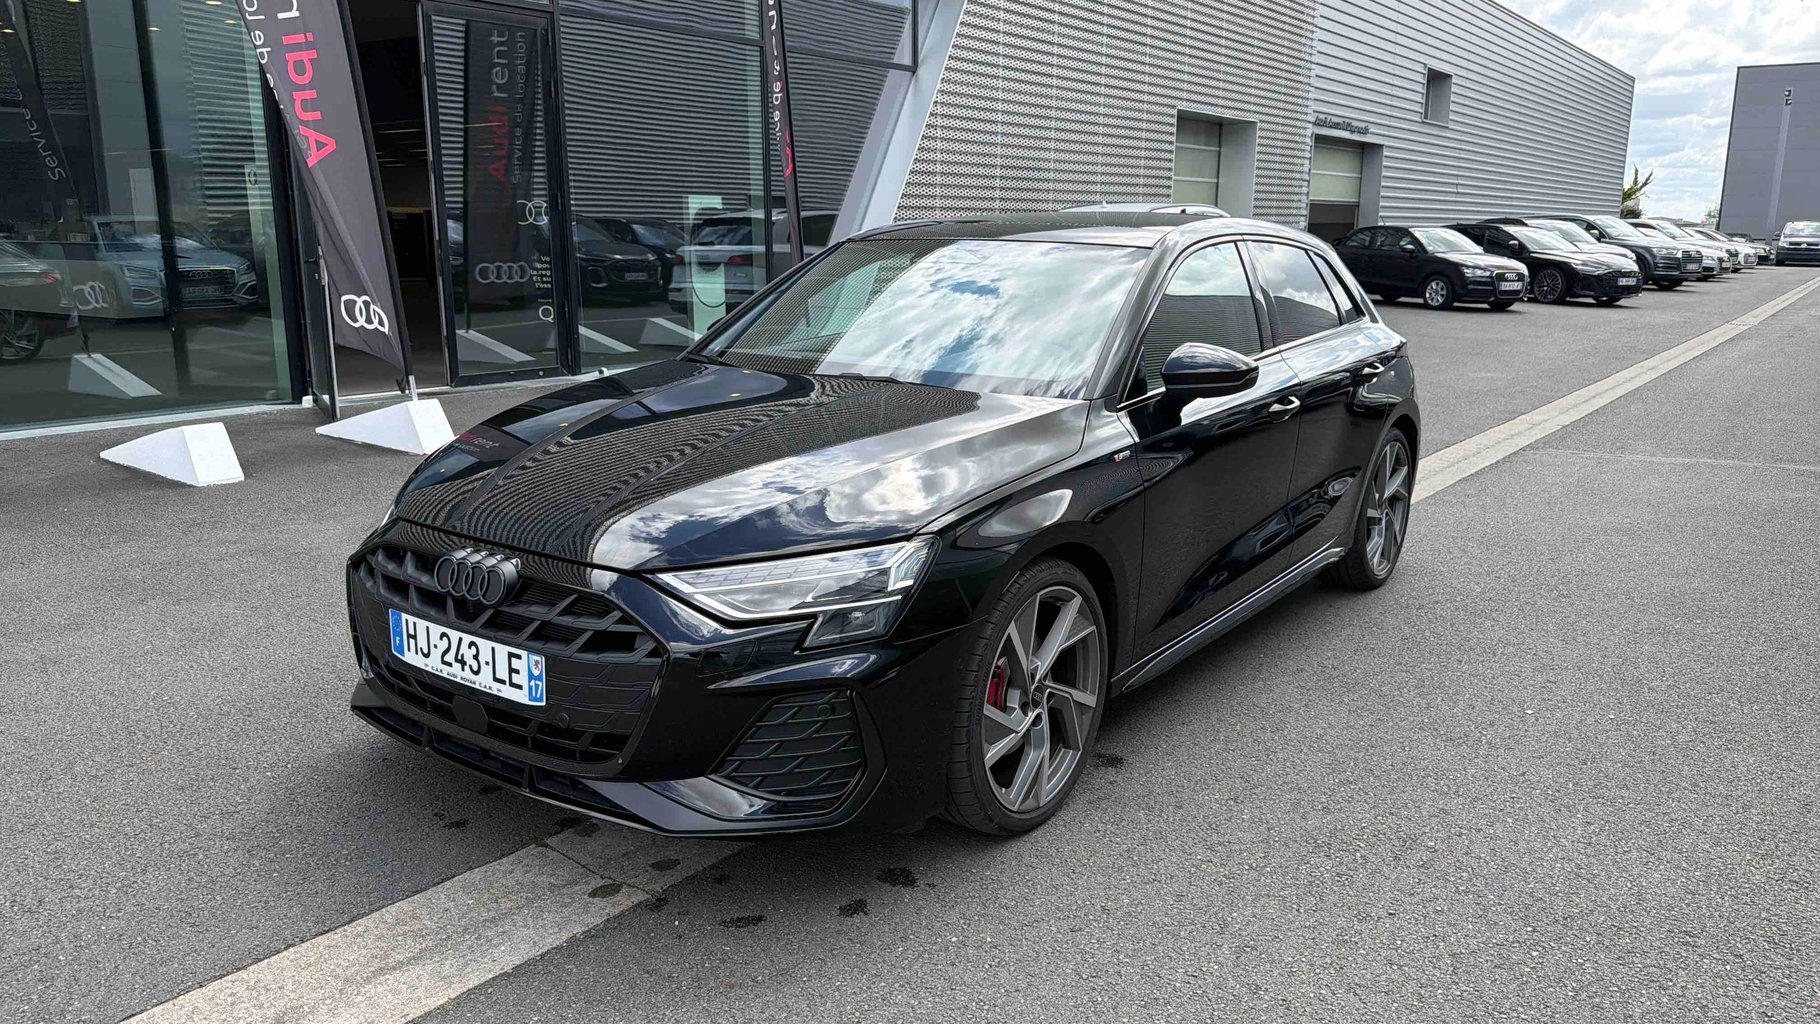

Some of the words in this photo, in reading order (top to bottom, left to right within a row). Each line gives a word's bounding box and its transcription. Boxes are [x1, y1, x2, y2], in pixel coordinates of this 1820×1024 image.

[489, 29, 509, 98] rent
[395, 636, 401, 647] F
[405, 618, 523, 691] HJ-243-LE
[446, 670, 459, 680] AUDI
[529, 679, 543, 699] 17
